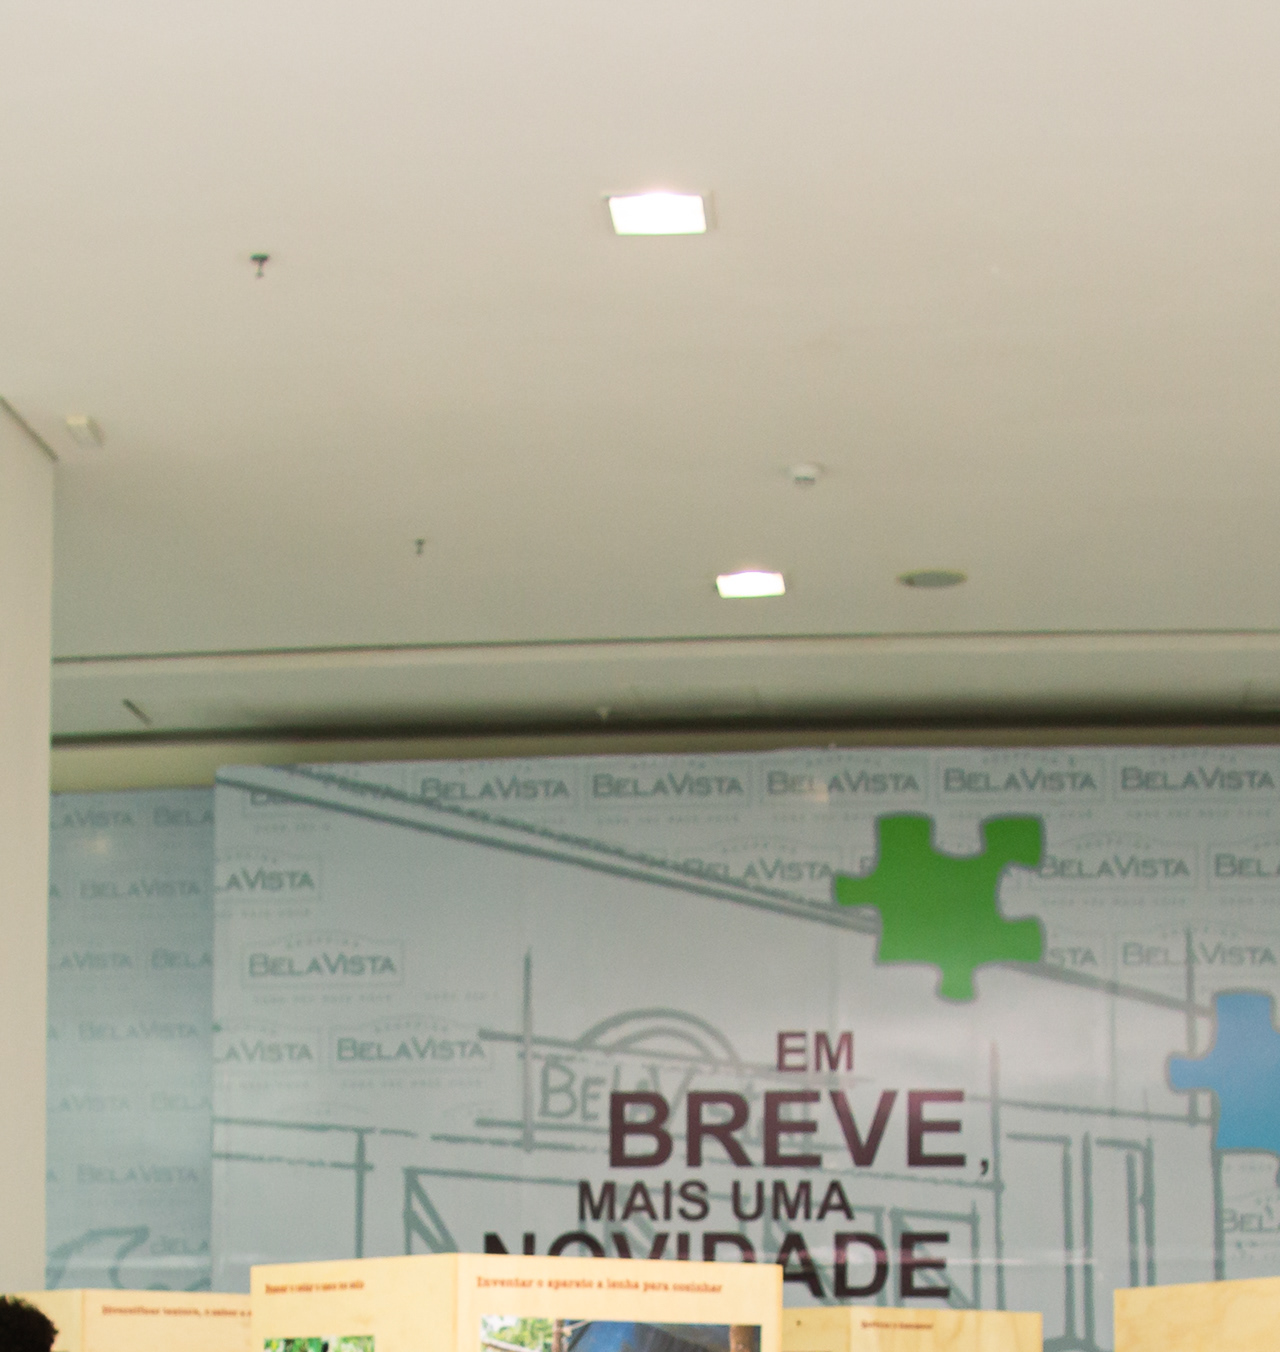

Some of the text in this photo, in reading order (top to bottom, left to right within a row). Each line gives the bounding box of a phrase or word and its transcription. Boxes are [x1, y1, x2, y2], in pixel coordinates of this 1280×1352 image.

[421, 776, 571, 802] BELAVISTA
[591, 772, 744, 798] BELAVISTA
[943, 767, 1097, 794] BELAVISTA
[1121, 766, 1276, 791] BELAVISTA
[218, 867, 317, 893] AVISTA
[247, 950, 399, 980] BELAVISTA
[222, 1038, 314, 1064] AVISTA
[335, 1035, 486, 1063] BELAVISTA
[777, 1030, 854, 1073] EM
[609, 1090, 990, 1177] BREVE,
[578, 1180, 855, 1222] MAIS UMA
